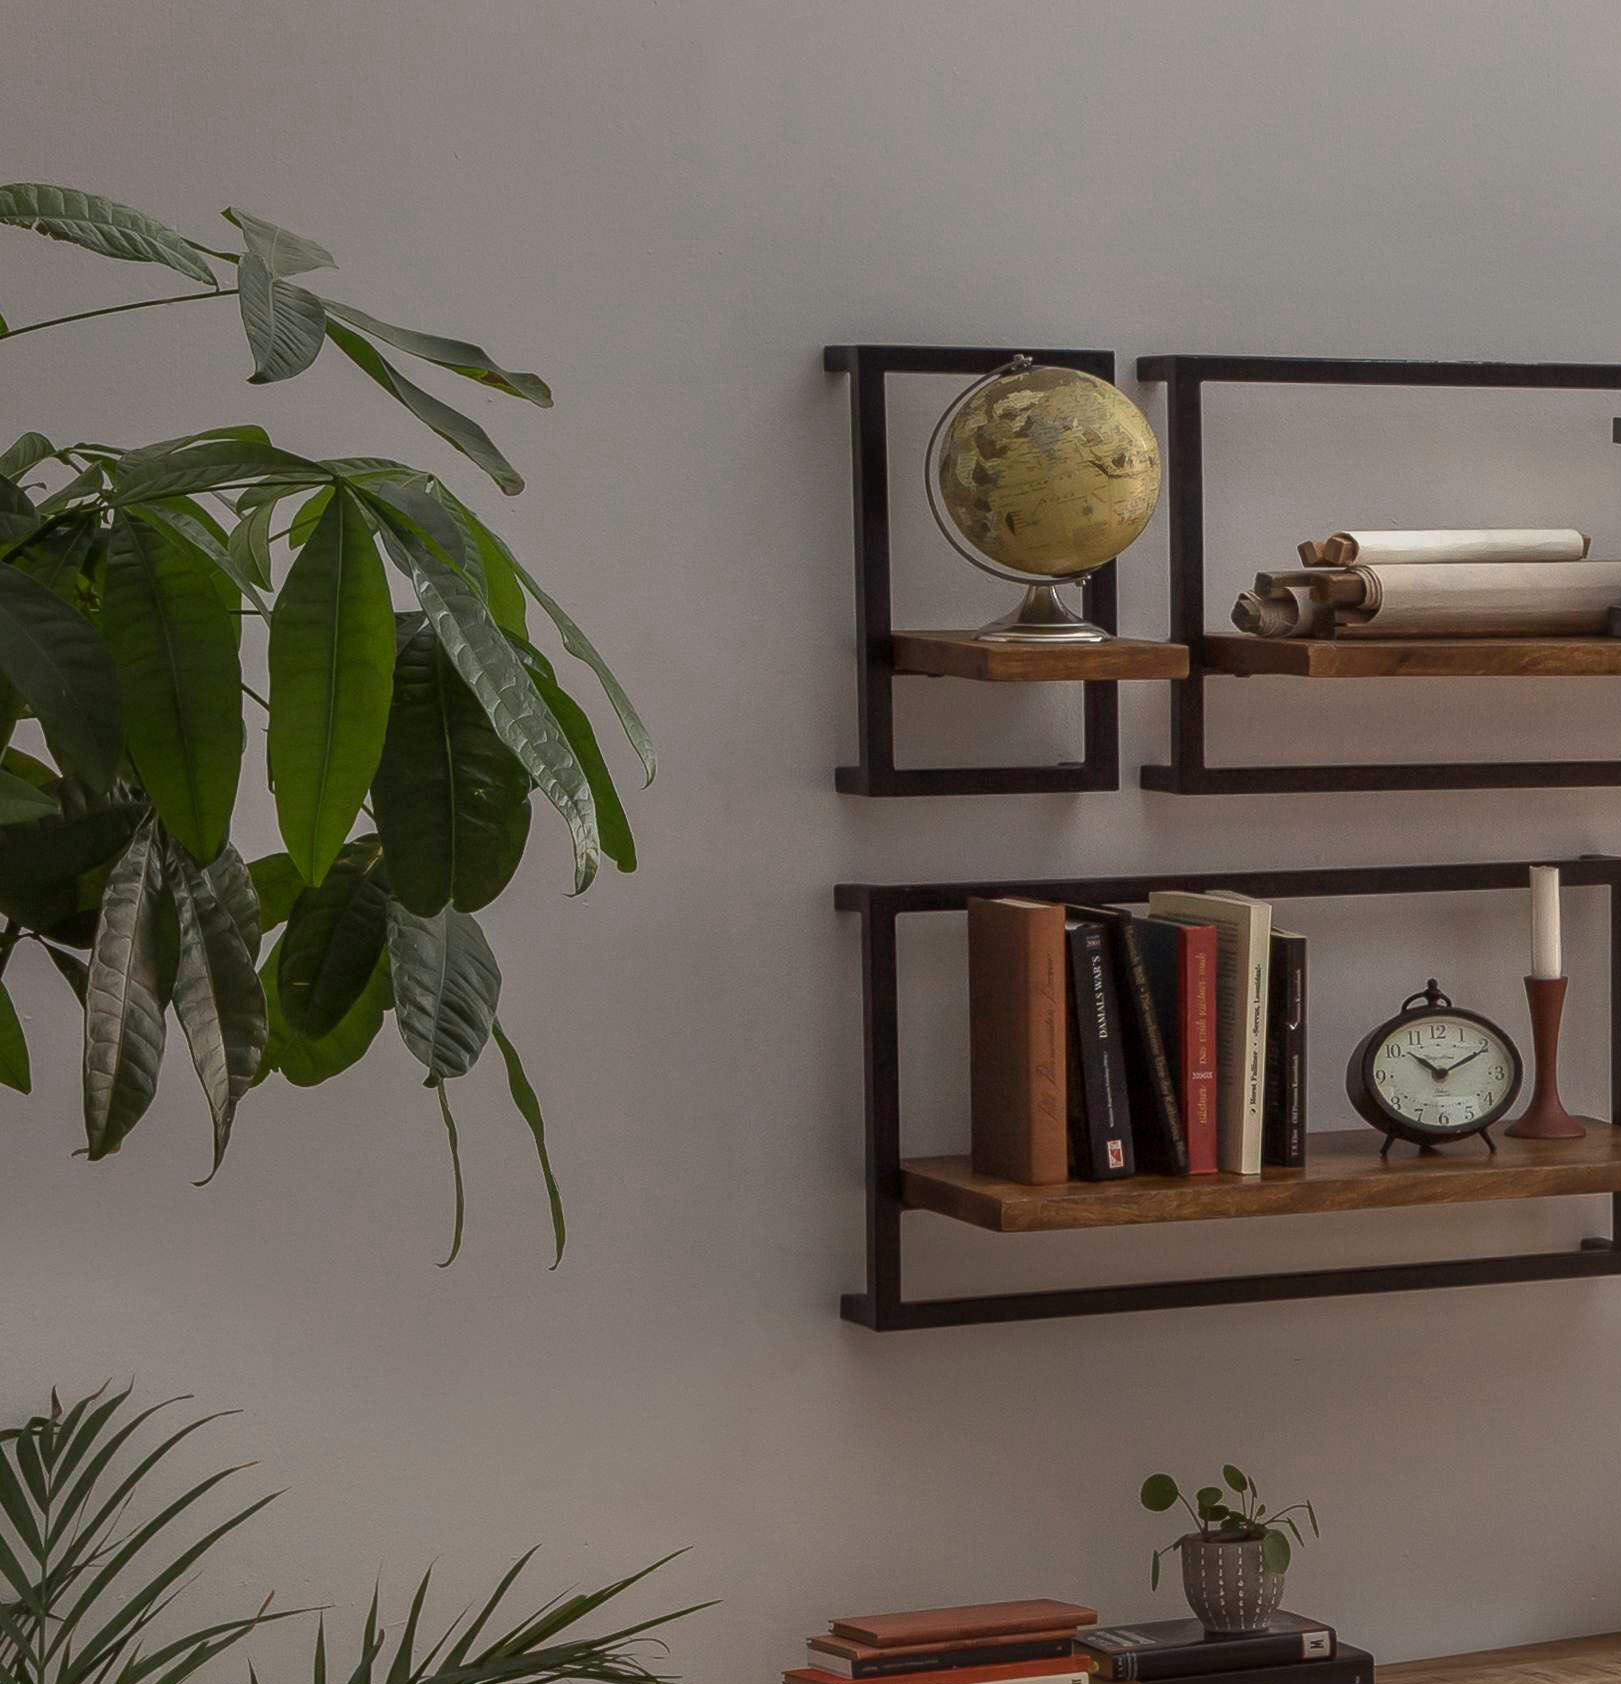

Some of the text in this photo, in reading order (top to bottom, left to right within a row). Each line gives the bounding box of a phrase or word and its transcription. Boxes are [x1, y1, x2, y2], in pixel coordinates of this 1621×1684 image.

[1095, 992, 1109, 1039] DAMALS
[1408, 1031, 1421, 1045] 11
[1430, 1025, 1446, 1039] 12
[1459, 1028, 1464, 1042] 1
[1385, 1044, 1401, 1058] 10
[1478, 1038, 1488, 1053] 2
[1376, 1070, 1386, 1085] 9
[1494, 1066, 1504, 1080] 3
[1391, 1096, 1401, 1111] 8
[1484, 1092, 1494, 1106] 4
[1414, 1109, 1424, 1122] 7
[1438, 1111, 1449, 1125] 6
[1465, 1106, 1474, 1121] 5
